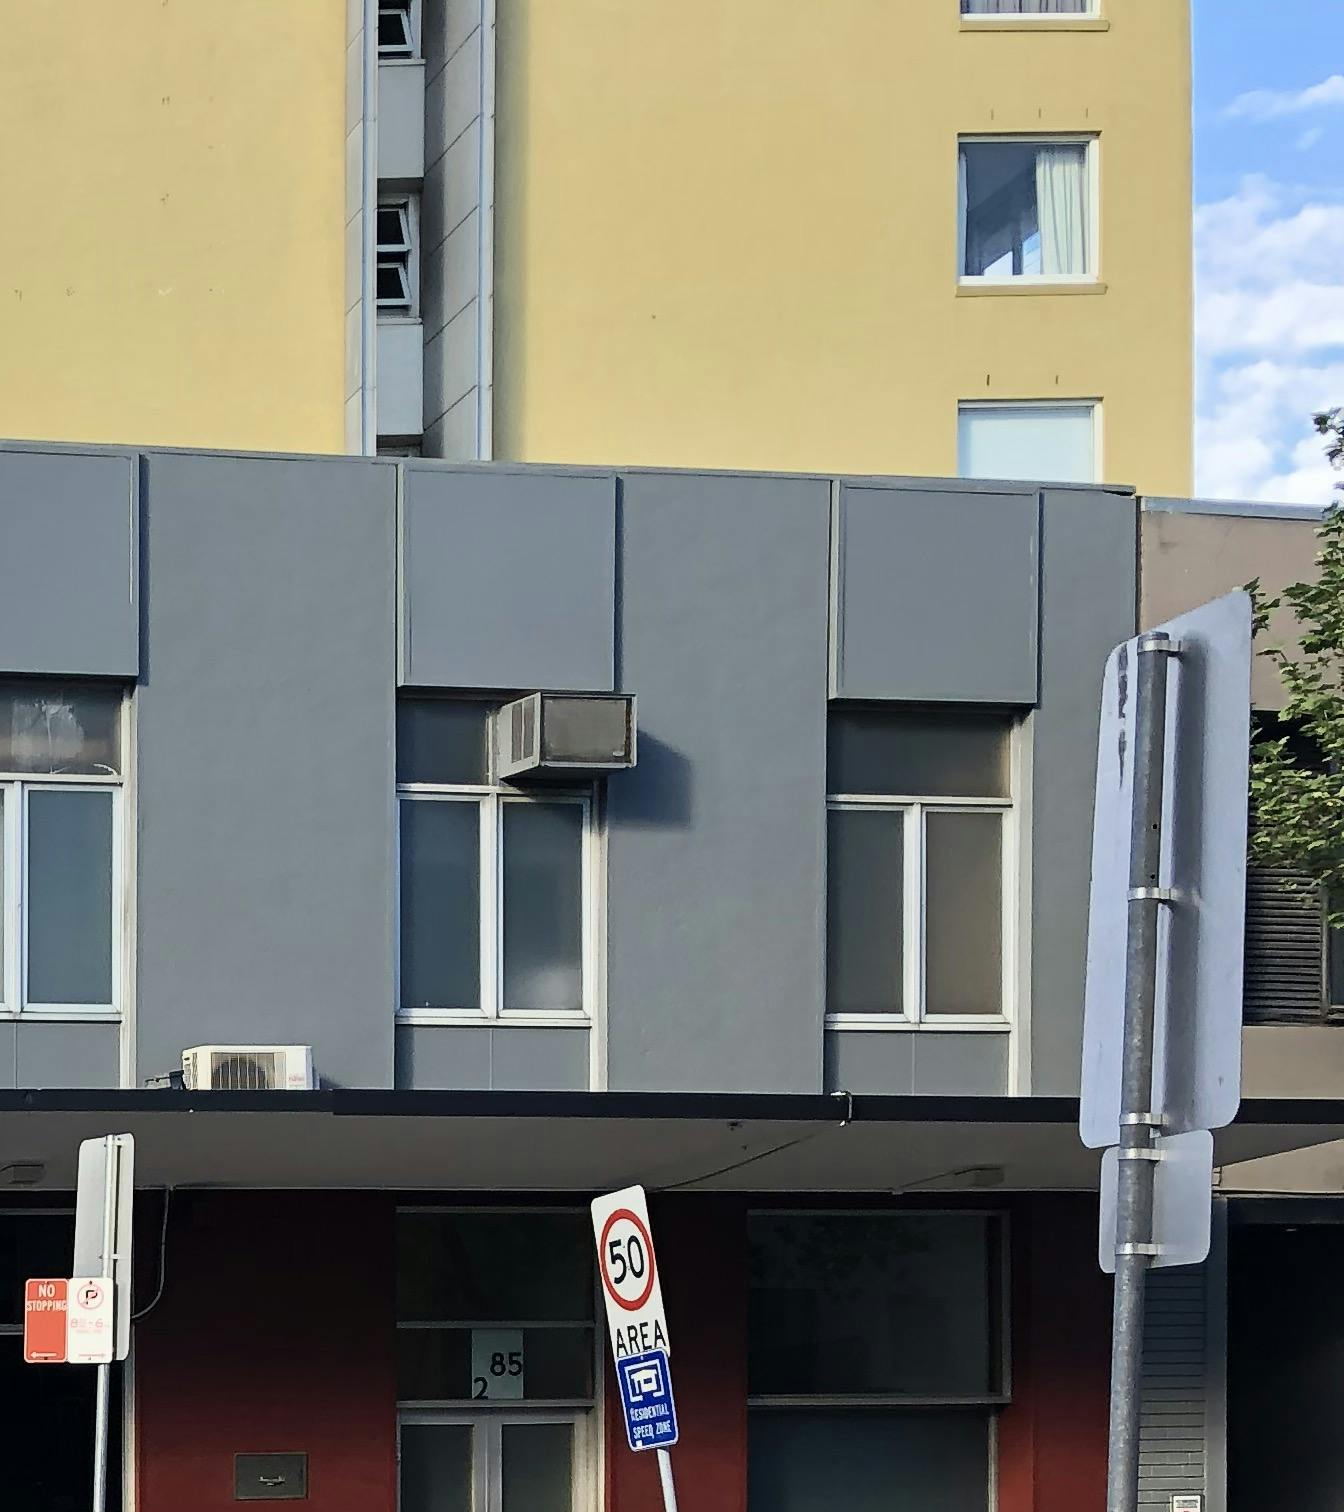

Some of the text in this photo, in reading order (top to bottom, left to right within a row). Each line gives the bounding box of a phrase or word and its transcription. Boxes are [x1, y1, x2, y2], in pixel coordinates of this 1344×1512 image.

[608, 1234, 645, 1285] 50
[38, 1283, 56, 1298] NO
[26, 1300, 67, 1312] STOPPING
[616, 1319, 666, 1358] AREA
[629, 1402, 670, 1422] RESIDENTIAL
[633, 1419, 672, 1440] SPEED ZONE
